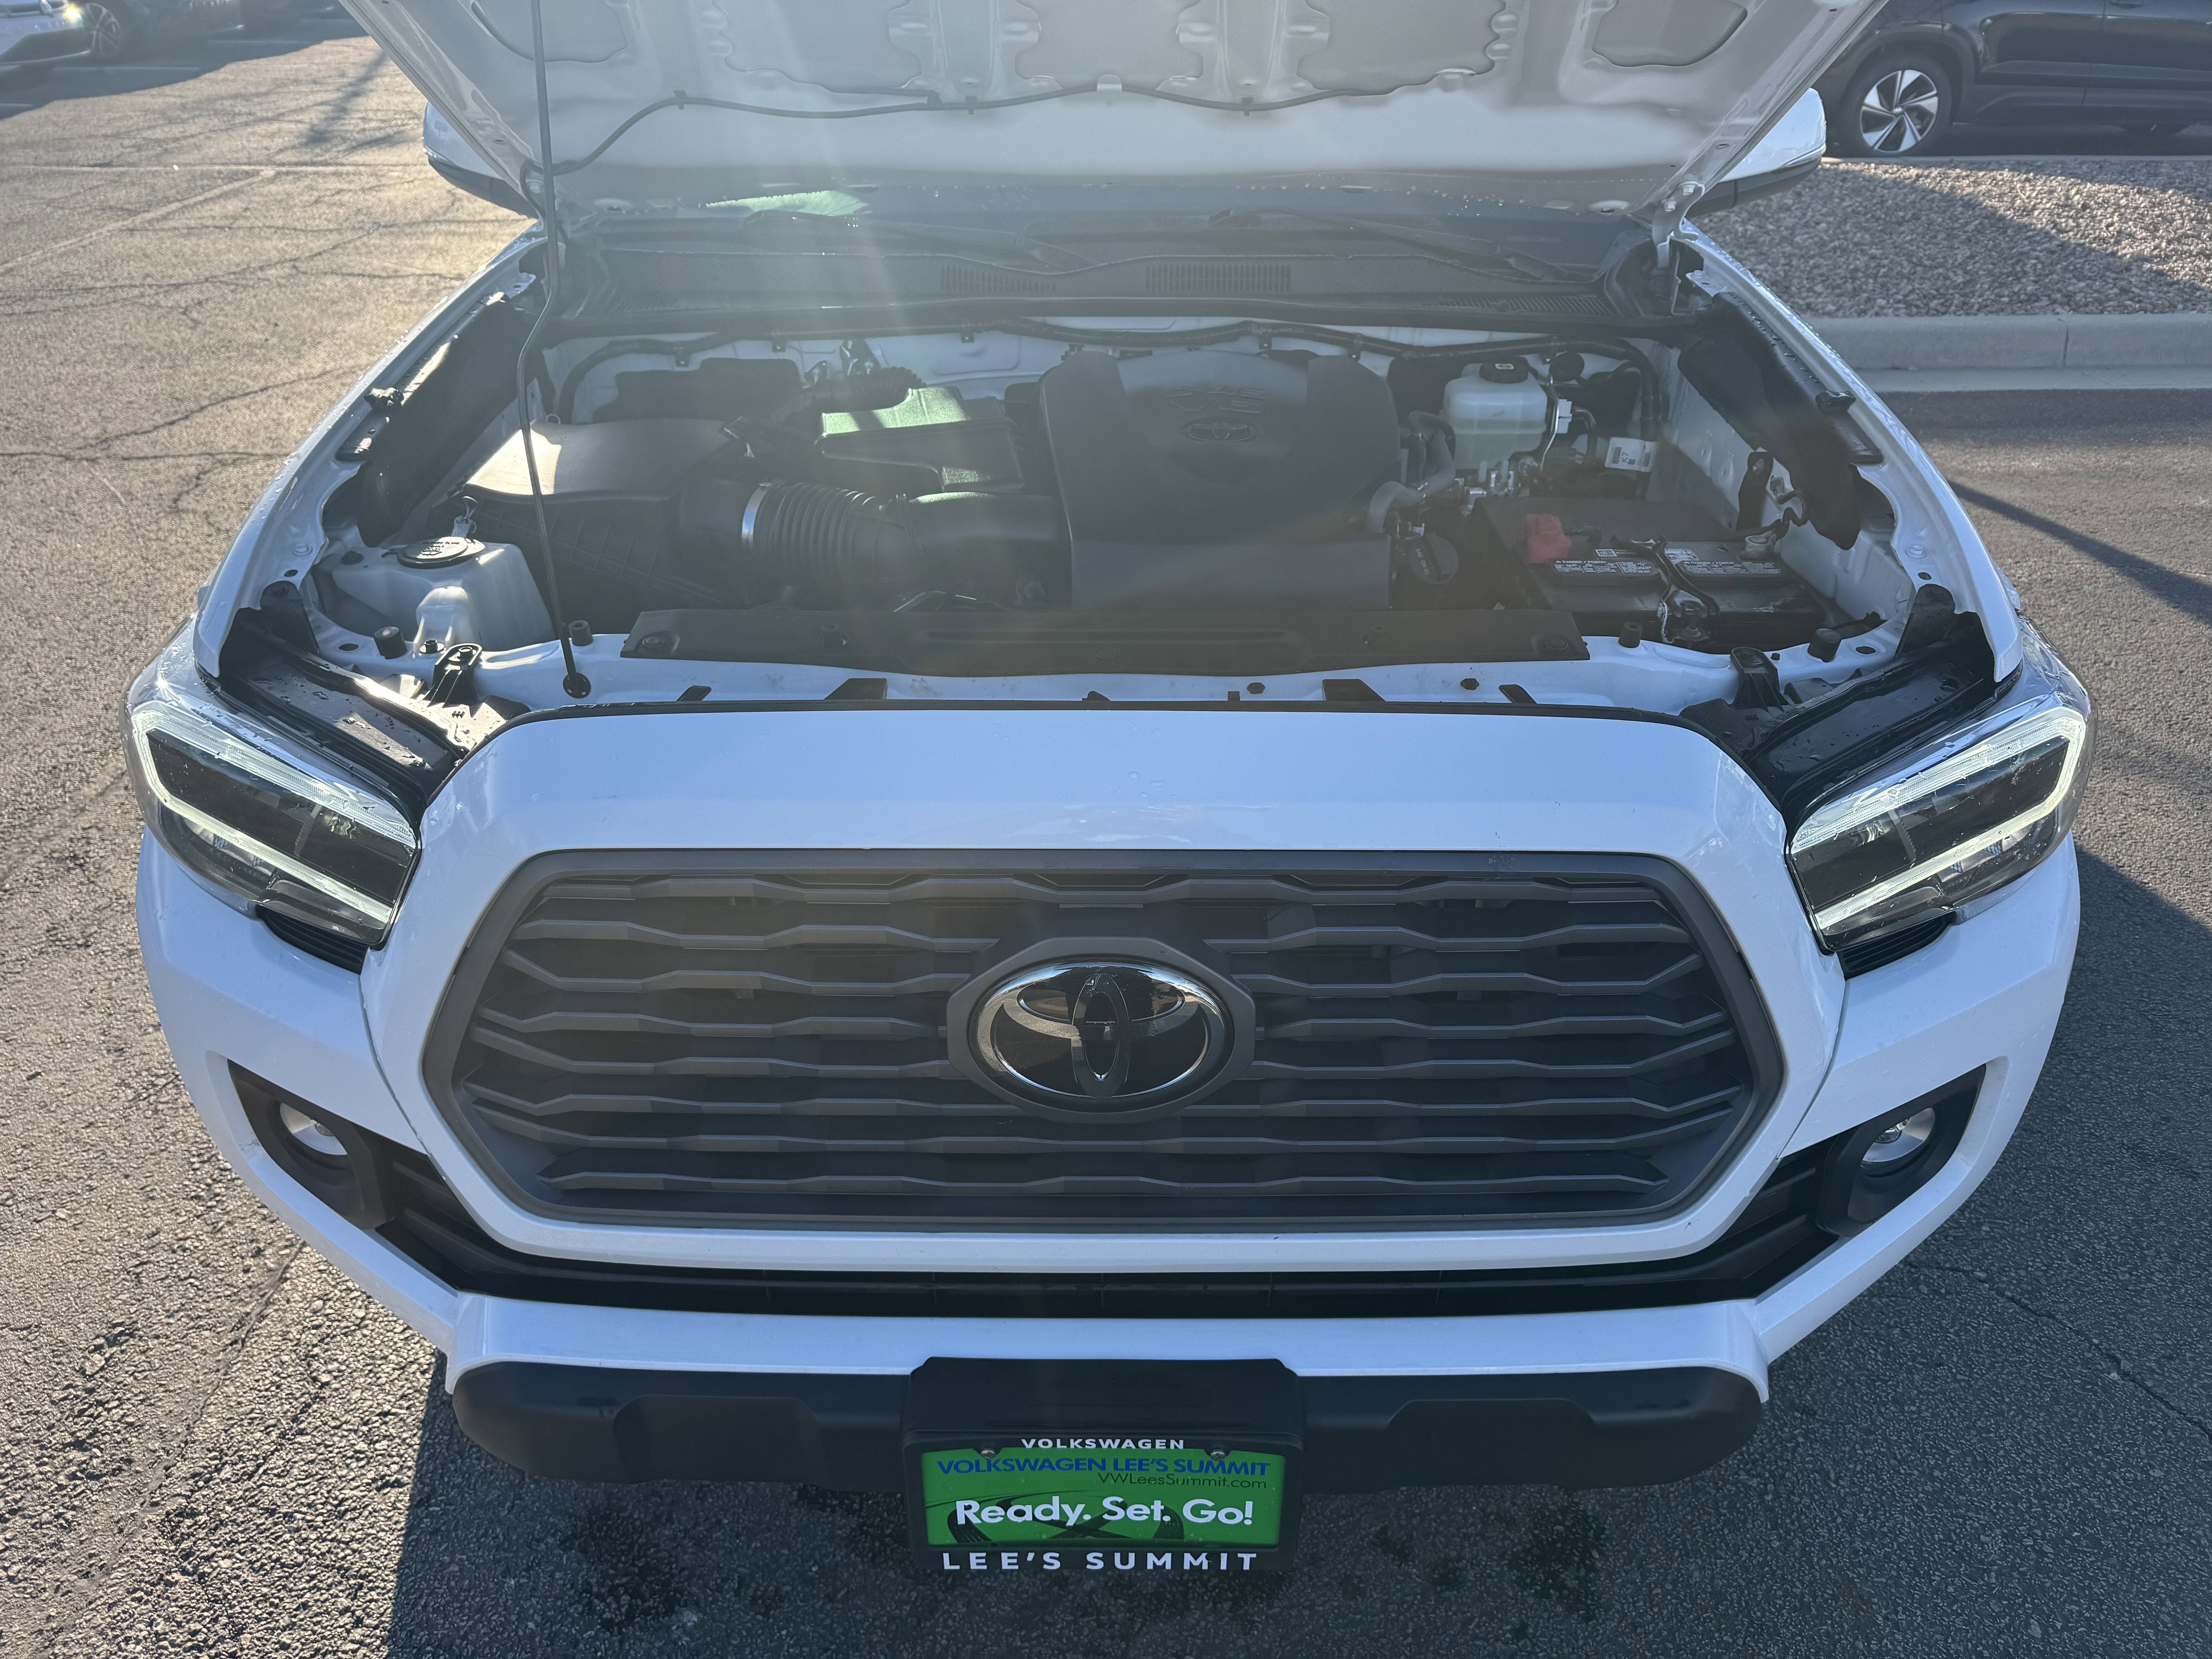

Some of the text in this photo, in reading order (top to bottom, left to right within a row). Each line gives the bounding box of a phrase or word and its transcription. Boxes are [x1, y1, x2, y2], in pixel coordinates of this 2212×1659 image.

[1169, 398, 1260, 414] V6
[1415, 548, 1424, 558] SAE
[1021, 1439, 1184, 1449] VOLKSWAGEN
[937, 1458, 1271, 1476] VOLKSWAGEN LEE'S SUMMIT
[1097, 1472, 1266, 1489] VWLeesSummit.com
[956, 1496, 1253, 1526] Ready. Set. Go!
[943, 1552, 1257, 1570] LEE'S SUMMIT
